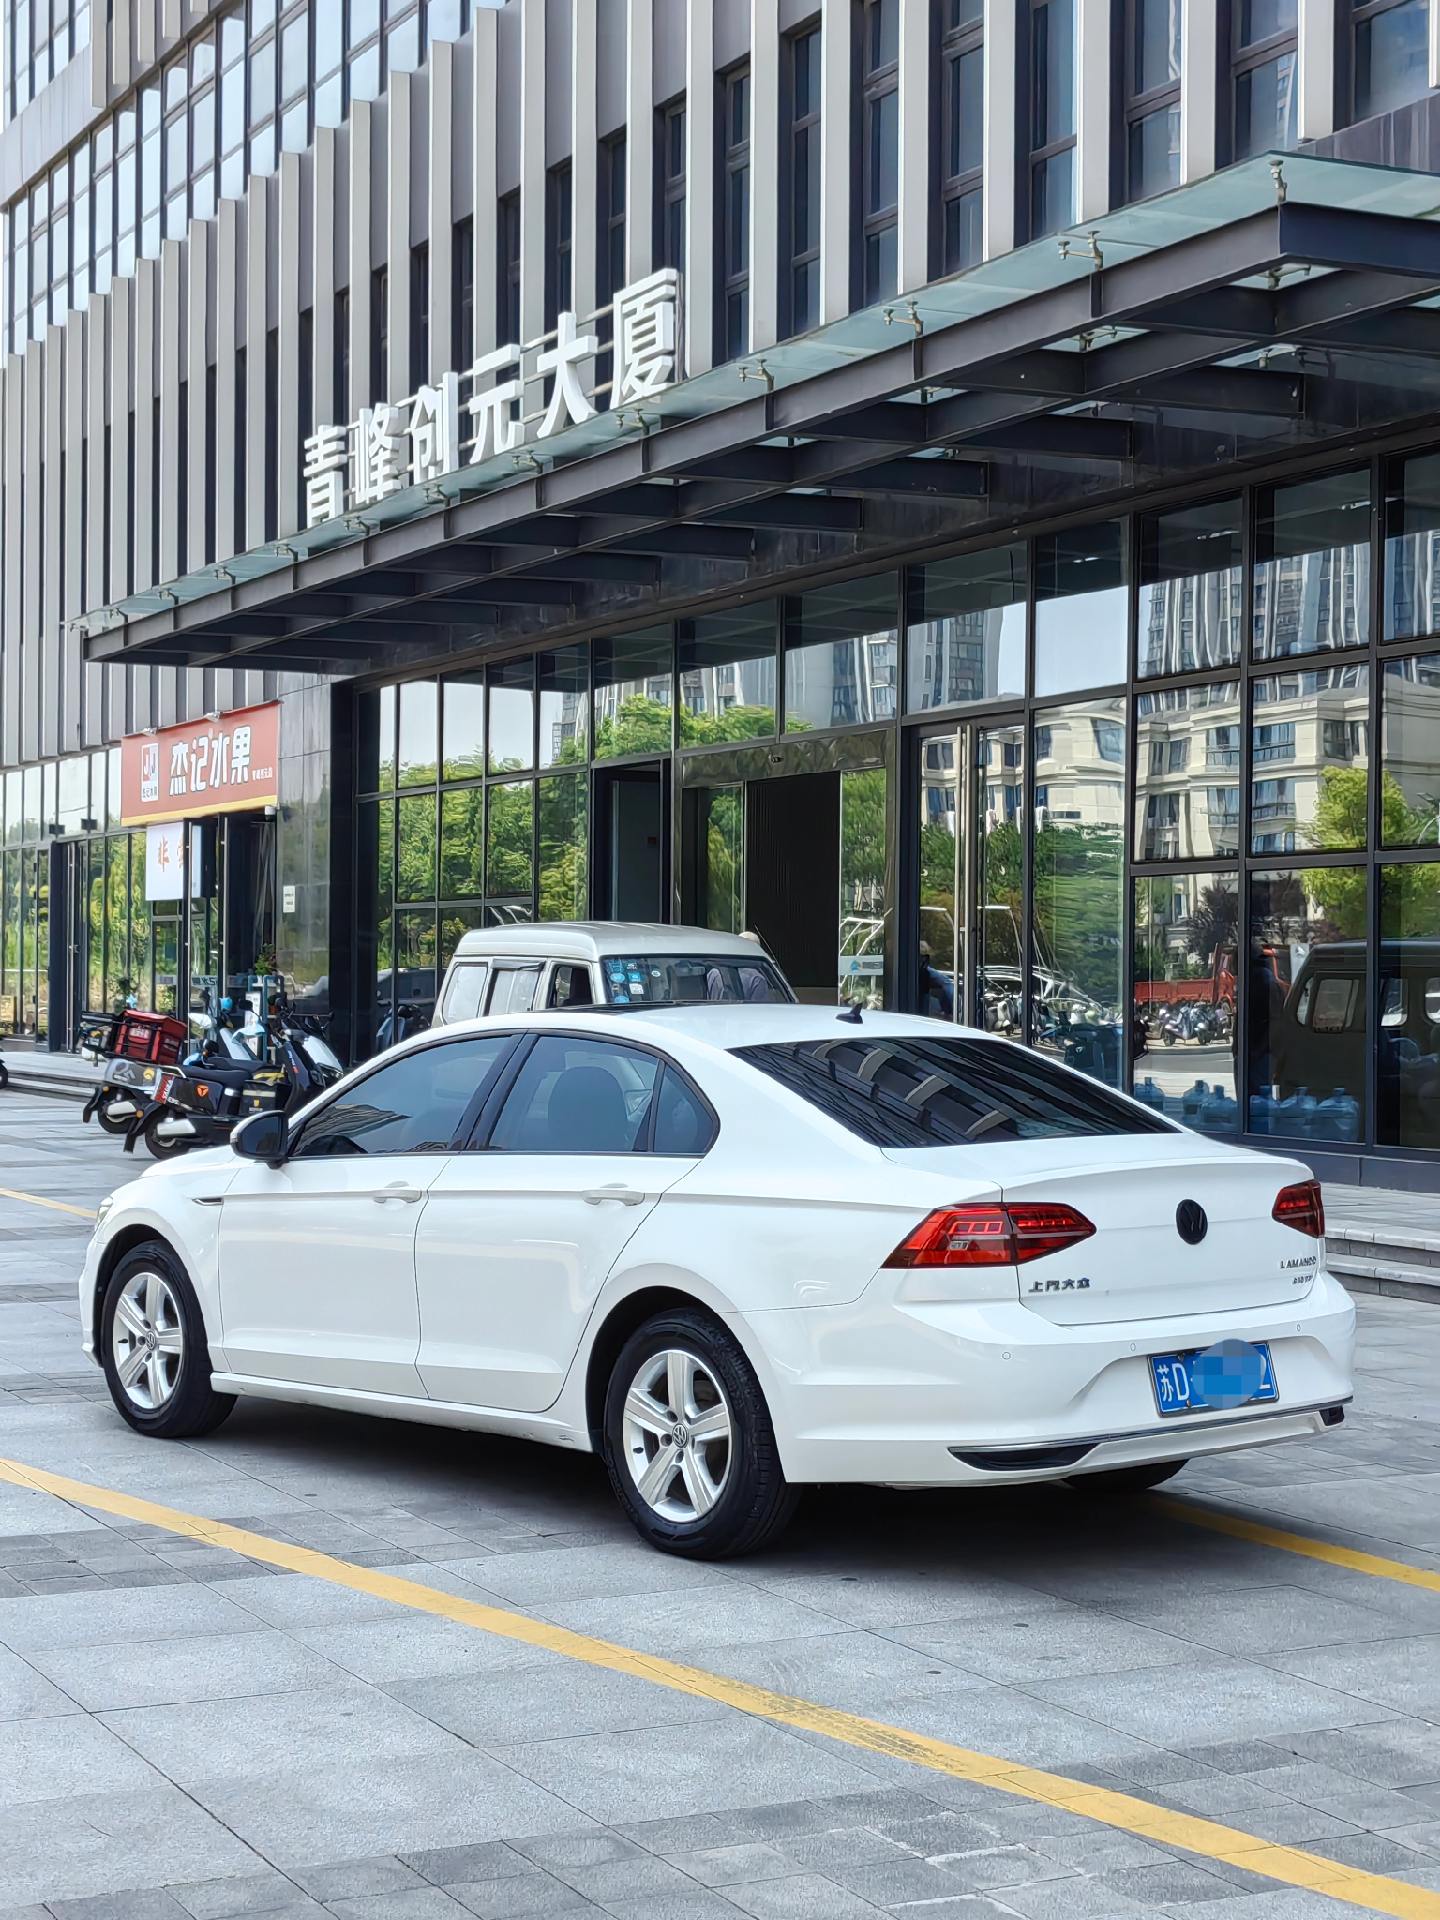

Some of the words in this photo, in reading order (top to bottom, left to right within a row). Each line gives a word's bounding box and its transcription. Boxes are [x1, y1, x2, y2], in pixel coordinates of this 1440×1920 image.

[303, 267, 679, 529] 青峰创元大厦
[169, 725, 251, 796] 杰记水果
